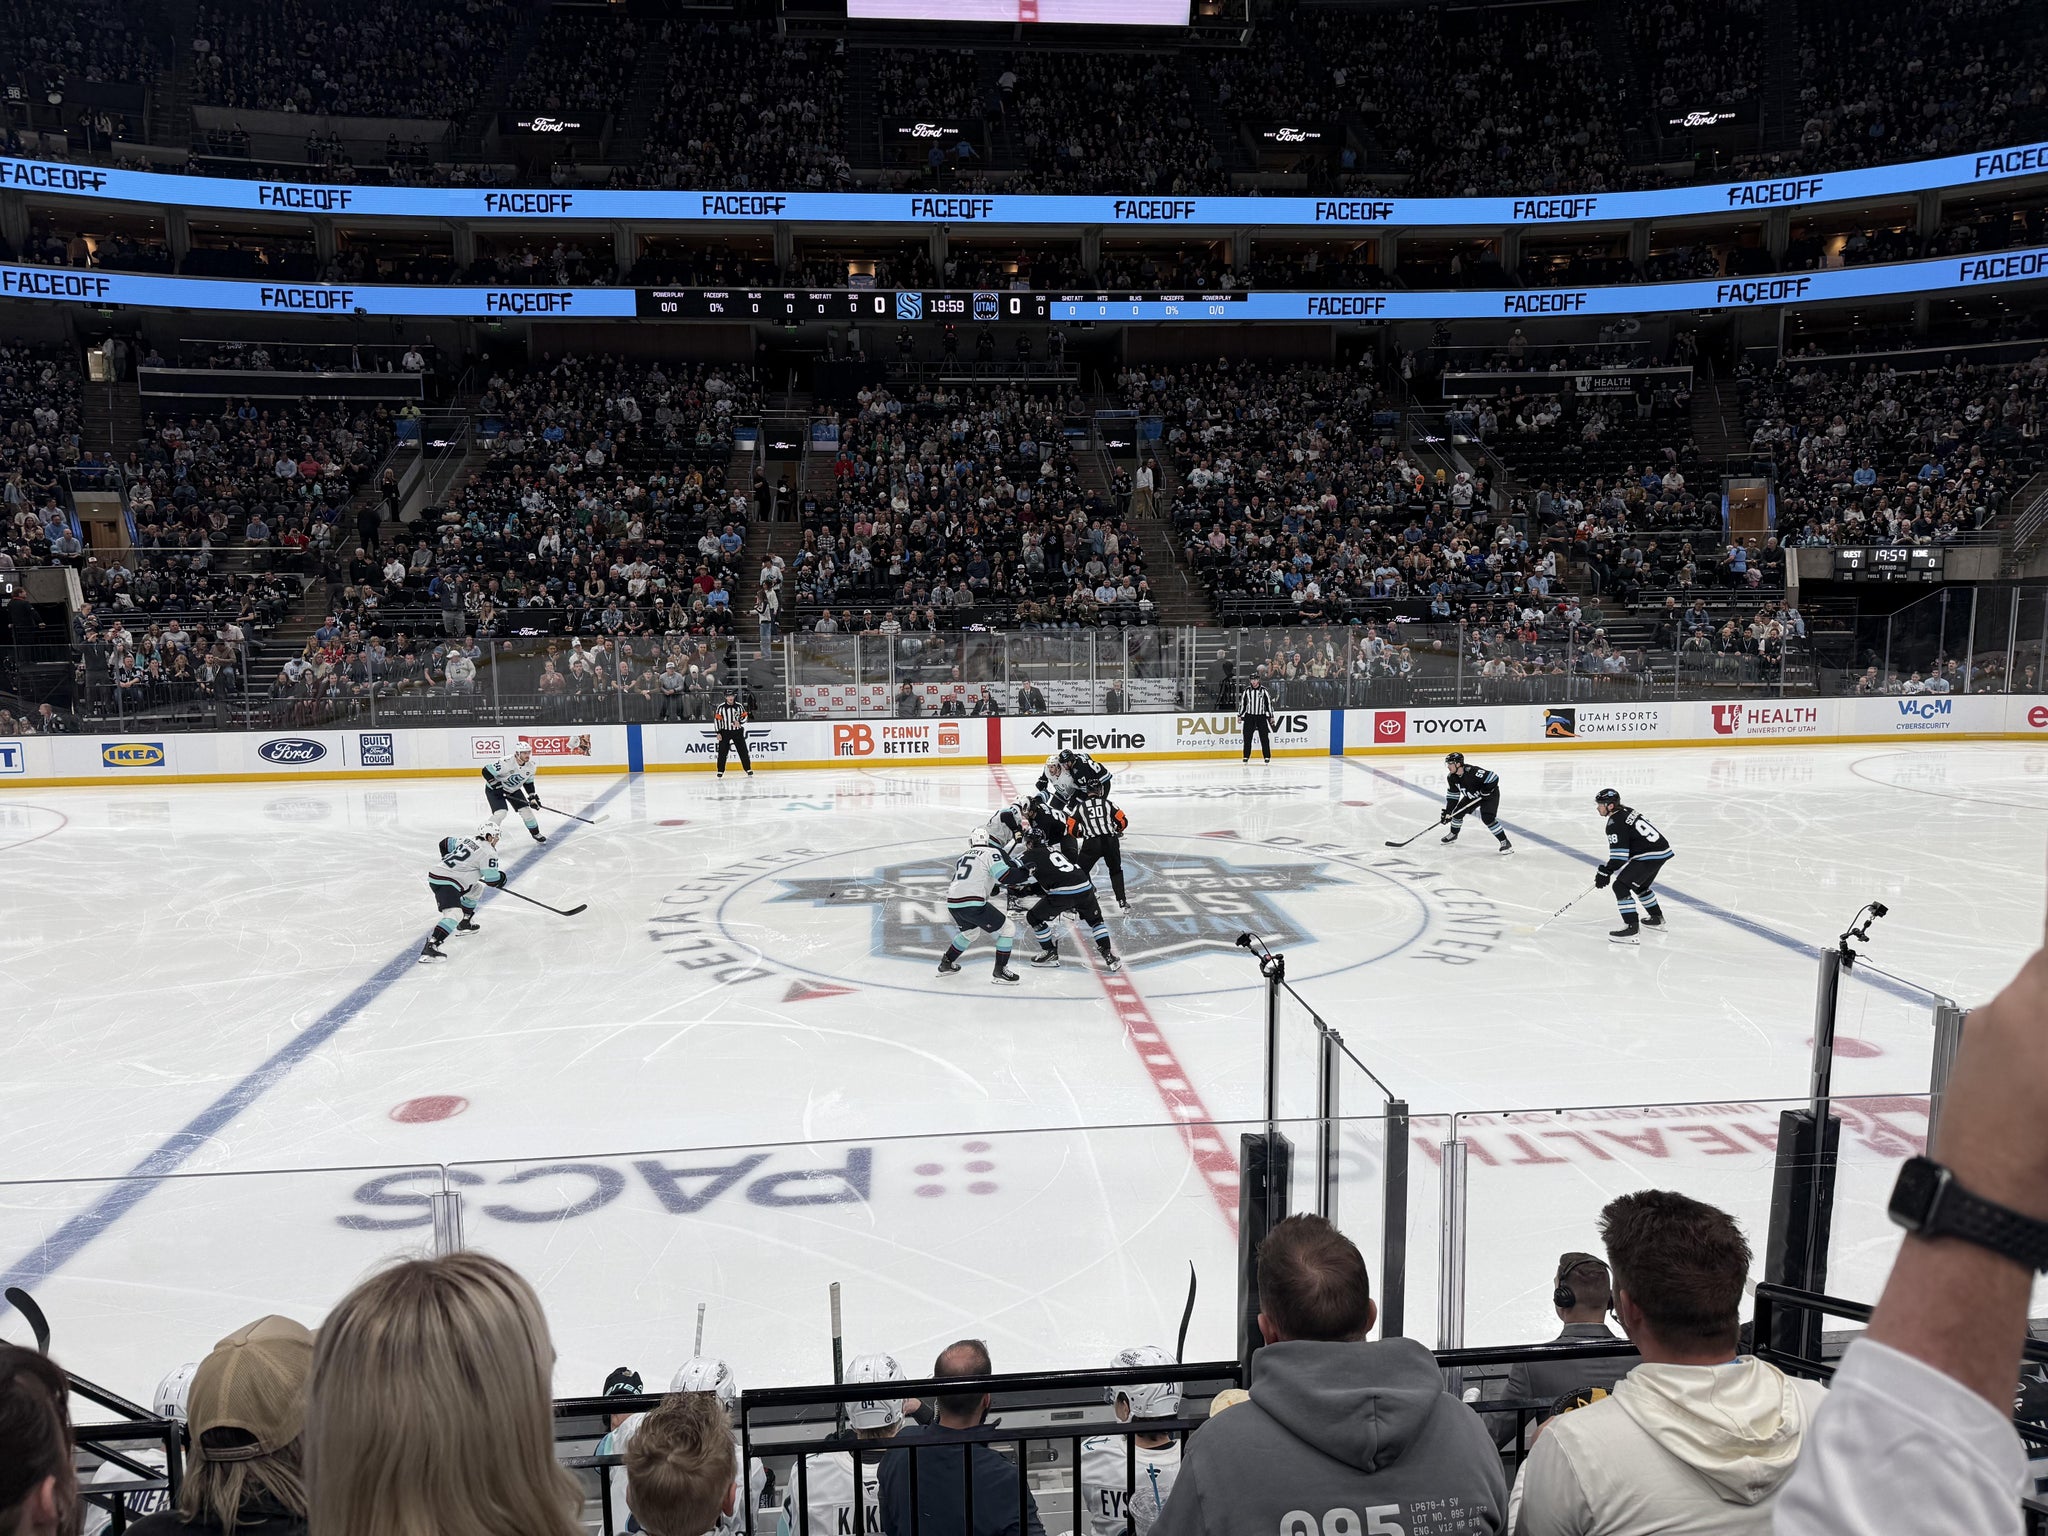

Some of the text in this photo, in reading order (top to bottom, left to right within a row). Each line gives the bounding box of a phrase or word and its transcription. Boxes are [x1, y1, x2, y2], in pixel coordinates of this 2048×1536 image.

[531, 117, 563, 132] Ford
[1683, 111, 1718, 127] Ford
[912, 123, 943, 137] Ford
[1276, 128, 1306, 141] Ford
[259, 185, 352, 211] FACEOFF
[1726, 178, 1824, 206] FACEOFF
[483, 193, 573, 214] FACEOFF
[702, 195, 787, 216] FACEOFF
[911, 197, 994, 220] FACEOFF
[1113, 200, 1196, 220] FACEOFF
[1513, 195, 1598, 220] FACEOFF
[1315, 201, 1395, 221] FACEOFF
[3, 270, 111, 298] FACEOFF
[1717, 277, 1812, 304] FACEOFF
[260, 287, 356, 312] FACEOFF
[486, 292, 574, 314] FACEOFF
[874, 297, 885, 313] 0
[930, 300, 965, 312] 19:59
[1010, 297, 1021, 314] 0
[1307, 295, 1387, 316] FACEOFF
[1503, 292, 1588, 313] FACEOFF
[661, 302, 677, 312] 0/0
[709, 303, 724, 313] 0%
[752, 303, 758, 313] 0
[787, 304, 793, 313] 0
[818, 304, 824, 314] 0
[850, 303, 857, 312] 0
[976, 302, 997, 312] UTAH
[1038, 306, 1044, 315] 0
[1069, 306, 1076, 316] 0
[1099, 306, 1106, 316] 0
[1132, 306, 1139, 316] 0
[1165, 305, 1179, 315] 0%
[1209, 305, 1225, 315] 0/0
[1594, 377, 1631, 387] HEALTH
[1875, 550, 1907, 561] 19:59
[1851, 559, 1858, 568] 0
[1928, 558, 1936, 567] 0
[5, 584, 13, 593] 0
[519, 628, 538, 636] Ford
[1579, 711, 1658, 722] UTAH SPORTS
[1748, 707, 1817, 724] HEALTH
[883, 726, 929, 739] PEANUT
[1177, 717, 1241, 735] PAUL
[1413, 719, 1487, 733] TOYOTA
[1579, 723, 1658, 732] COMMISSION
[1897, 722, 1951, 730] CYBERSECURITY
[362, 736, 389, 746] BUILT
[475, 740, 500, 750] G2G
[534, 738, 561, 748] G2G
[833, 724, 875, 756] PB
[1057, 728, 1145, 750] Filevine
[1177, 736, 1308, 747] Property Experts
[271, 742, 313, 760] Ford
[749, 742, 788, 752] FIRST
[841, 742, 854, 756] fit
[883, 741, 929, 754] BETTER
[108, 750, 159, 760] IKEA
[364, 755, 391, 763] TOUGH
[1475, 769, 1485, 778] 50
[1087, 806, 1104, 818] 30
[1262, 835, 1502, 967] DELTA CENTER
[649, 847, 827, 986] DELTA CENTER
[1549, 1104, 1764, 1125] UNIVERSITY
[336, 1147, 872, 1232] PACS
[1165, 1381, 1175, 1395] 21
[165, 1404, 175, 1417] 10
[1449, 1497, 1459, 1507] SV
[1412, 1514, 1428, 1525] LOT
[1432, 1511, 1447, 1522] NO.
[1450, 1508, 1465, 1519] 095
[1413, 1526, 1434, 1536] ENG.
[1439, 1522, 1453, 1533] V12
[1456, 1520, 1466, 1530] HP
